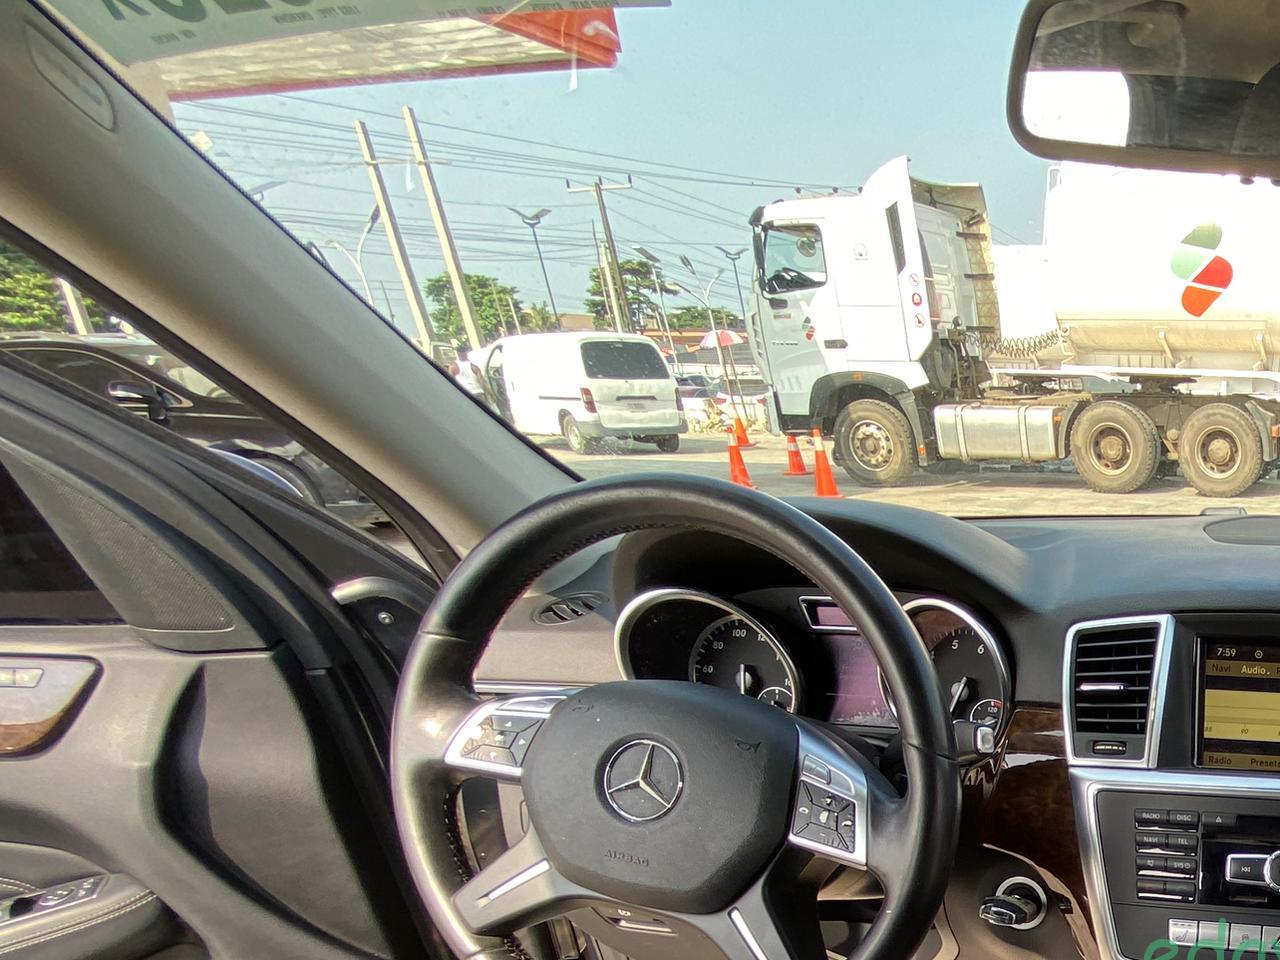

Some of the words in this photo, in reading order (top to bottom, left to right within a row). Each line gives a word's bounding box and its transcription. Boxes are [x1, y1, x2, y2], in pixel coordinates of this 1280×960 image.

[732, 629, 747, 638] 100
[712, 641, 724, 650] 80
[951, 639, 959, 650] 5
[977, 644, 985, 654] 6
[1216, 647, 1237, 658] 7:59
[702, 665, 714, 673] 60
[1211, 663, 1232, 673] Navi
[1208, 755, 1233, 765] Radio
